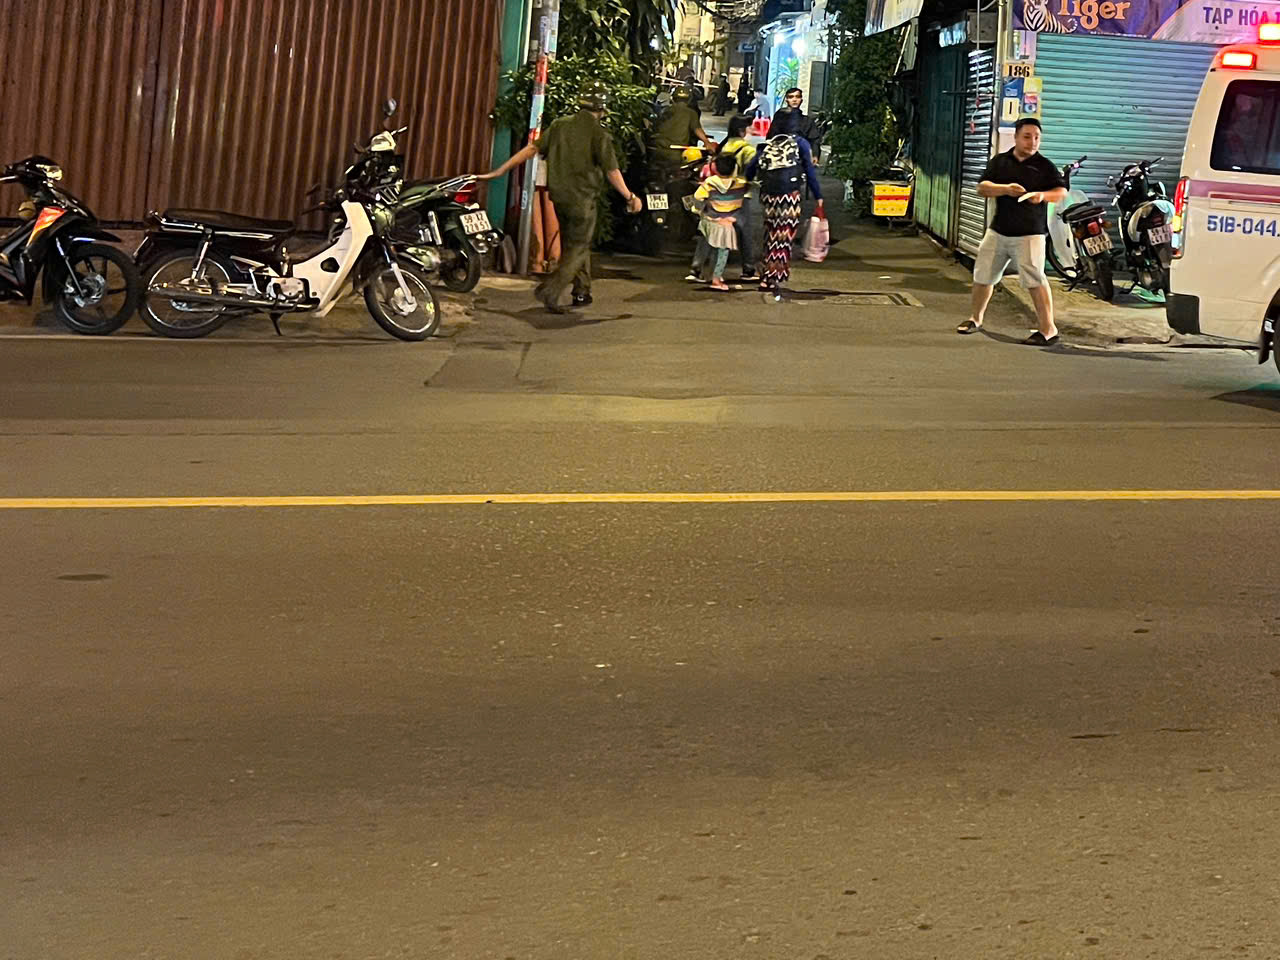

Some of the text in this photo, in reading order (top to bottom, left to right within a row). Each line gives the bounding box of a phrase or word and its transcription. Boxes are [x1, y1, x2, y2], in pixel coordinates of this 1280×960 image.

[1203, 5, 1234, 30] TẠP
[1239, 4, 1268, 27] HÓA
[1008, 65, 1030, 77] 186
